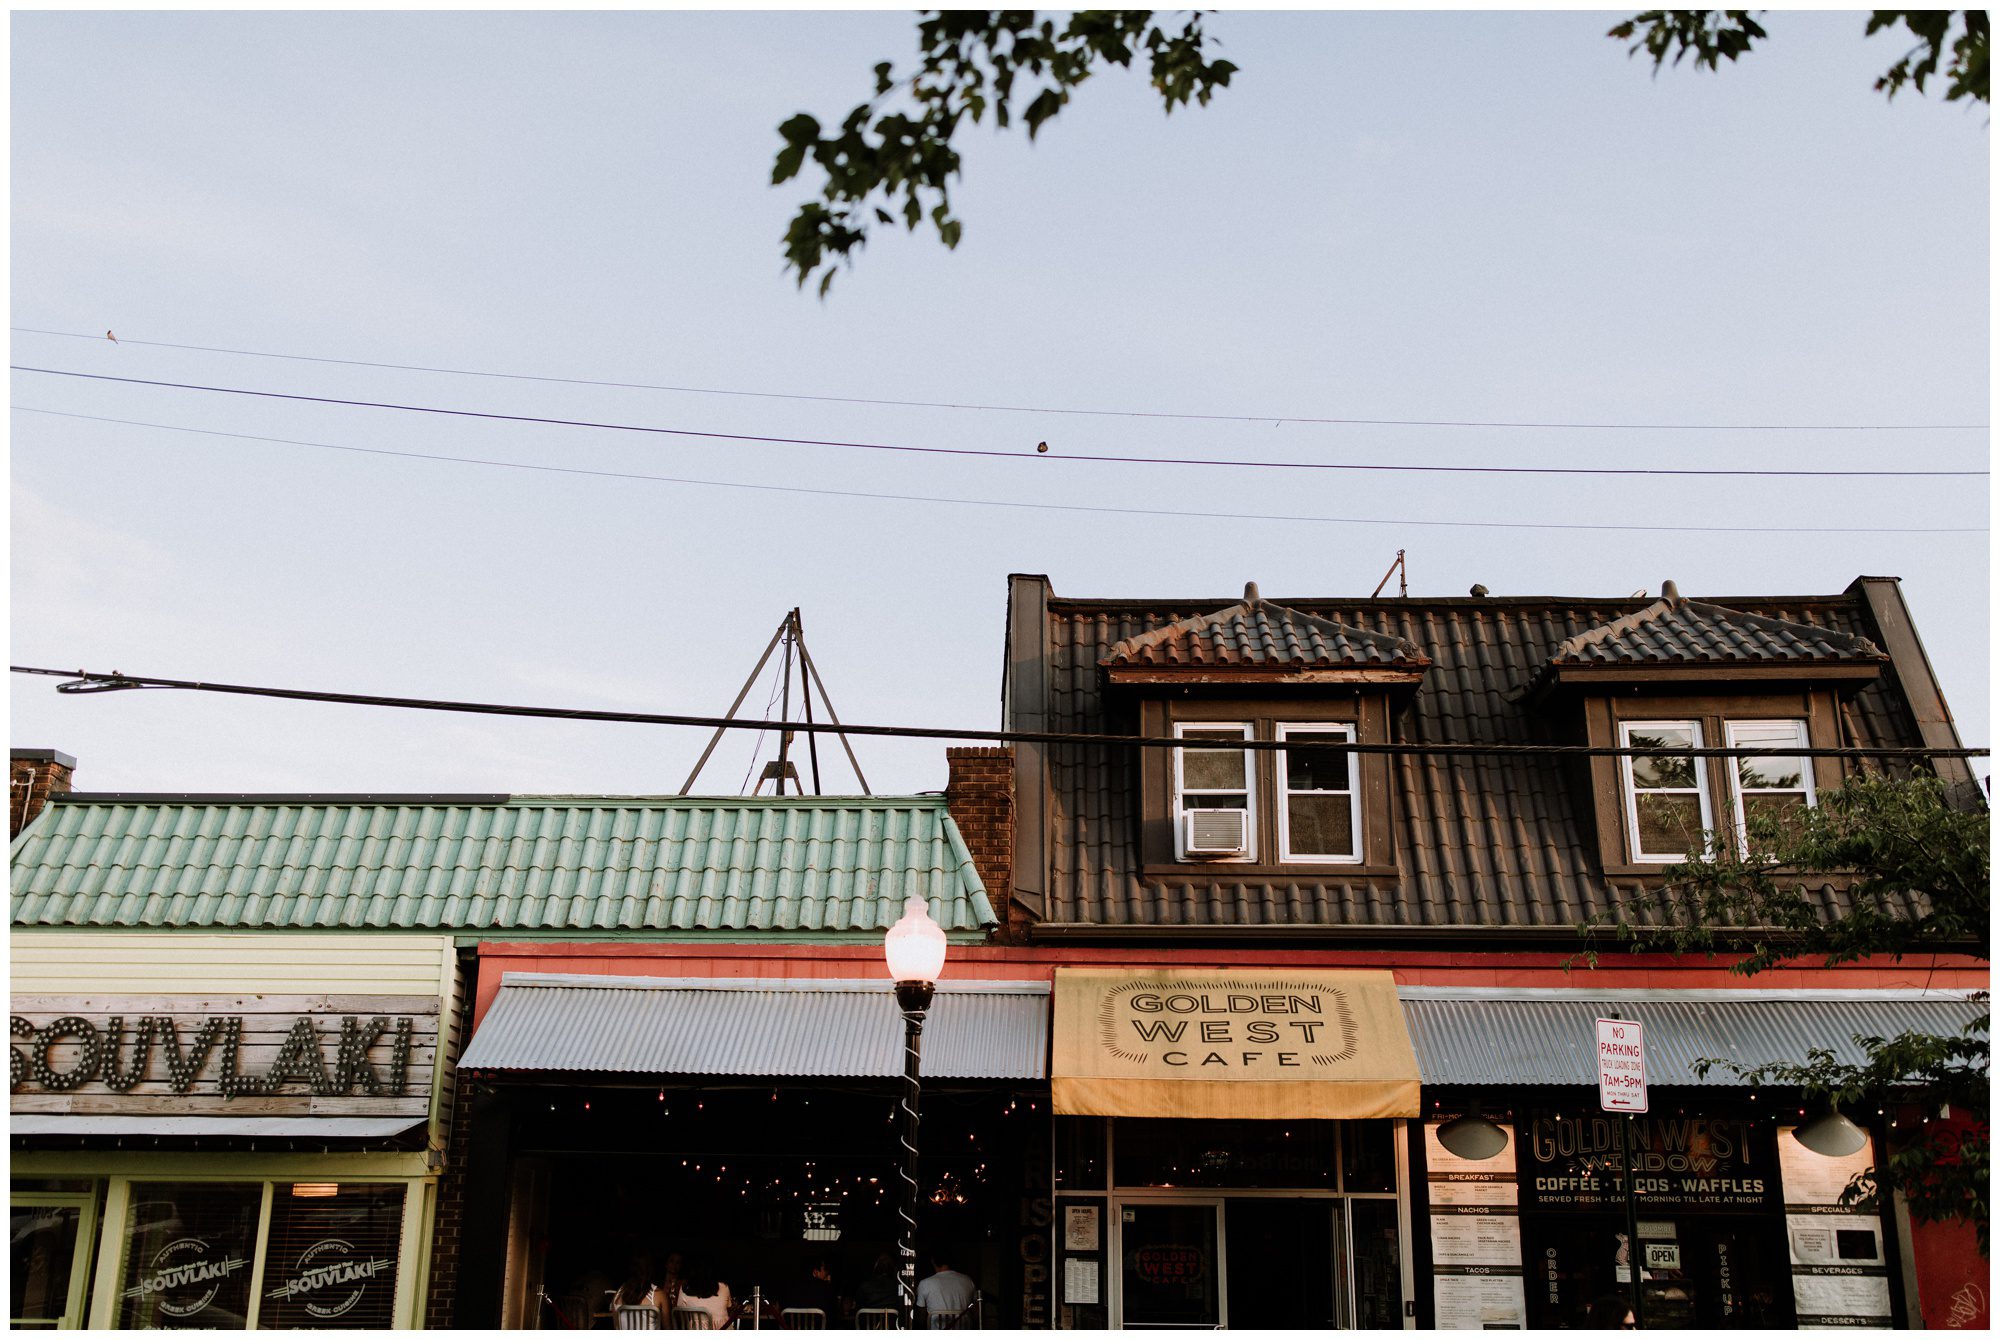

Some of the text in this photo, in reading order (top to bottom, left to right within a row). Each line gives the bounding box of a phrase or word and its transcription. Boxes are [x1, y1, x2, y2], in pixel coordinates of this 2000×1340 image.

[1130, 993, 1322, 1014] GOLDEN
[1131, 1020, 1325, 1044] WEST
[1612, 1027, 1625, 1039] NO
[1600, 1043, 1640, 1057] PARKING
[1162, 1051, 1301, 1067] CAFE
[1602, 1058, 1641, 1072] TRUCK LOADING ZONE
[1603, 1073, 1642, 1089] 7AM-5PM
[1532, 1117, 1752, 1165] GOLDEN WEST
[1578, 1153, 1718, 1172] WINDOW
[1536, 1177, 1764, 1193] COFFEE TCOS WAFFLES
[1538, 1195, 1764, 1204] SERVED FRESH EAR MORNING TIL LATE AT NIGHT
[1810, 1206, 1851, 1214] SPECIALS
[159, 1242, 204, 1264] AUTHENTIC
[304, 1243, 349, 1265] AUTHENTIC
[1142, 1250, 1198, 1262] GOLDEN
[1651, 1250, 1675, 1263] OPEN
[142, 1260, 227, 1294] SOUVLAKI
[1143, 1263, 1198, 1275] WEST
[1546, 1247, 1560, 1304] ORDER
[1811, 1267, 1863, 1275] BEVERAGES
[288, 1261, 373, 1295] SOUVLAKI
[1020, 1233, 1048, 1330] OPE
[1717, 1243, 1733, 1316] PICK UP
[160, 1300, 185, 1314] GREEK
[306, 1302, 332, 1314] GREEK
[1820, 1317, 1867, 1325] DESSERTS
